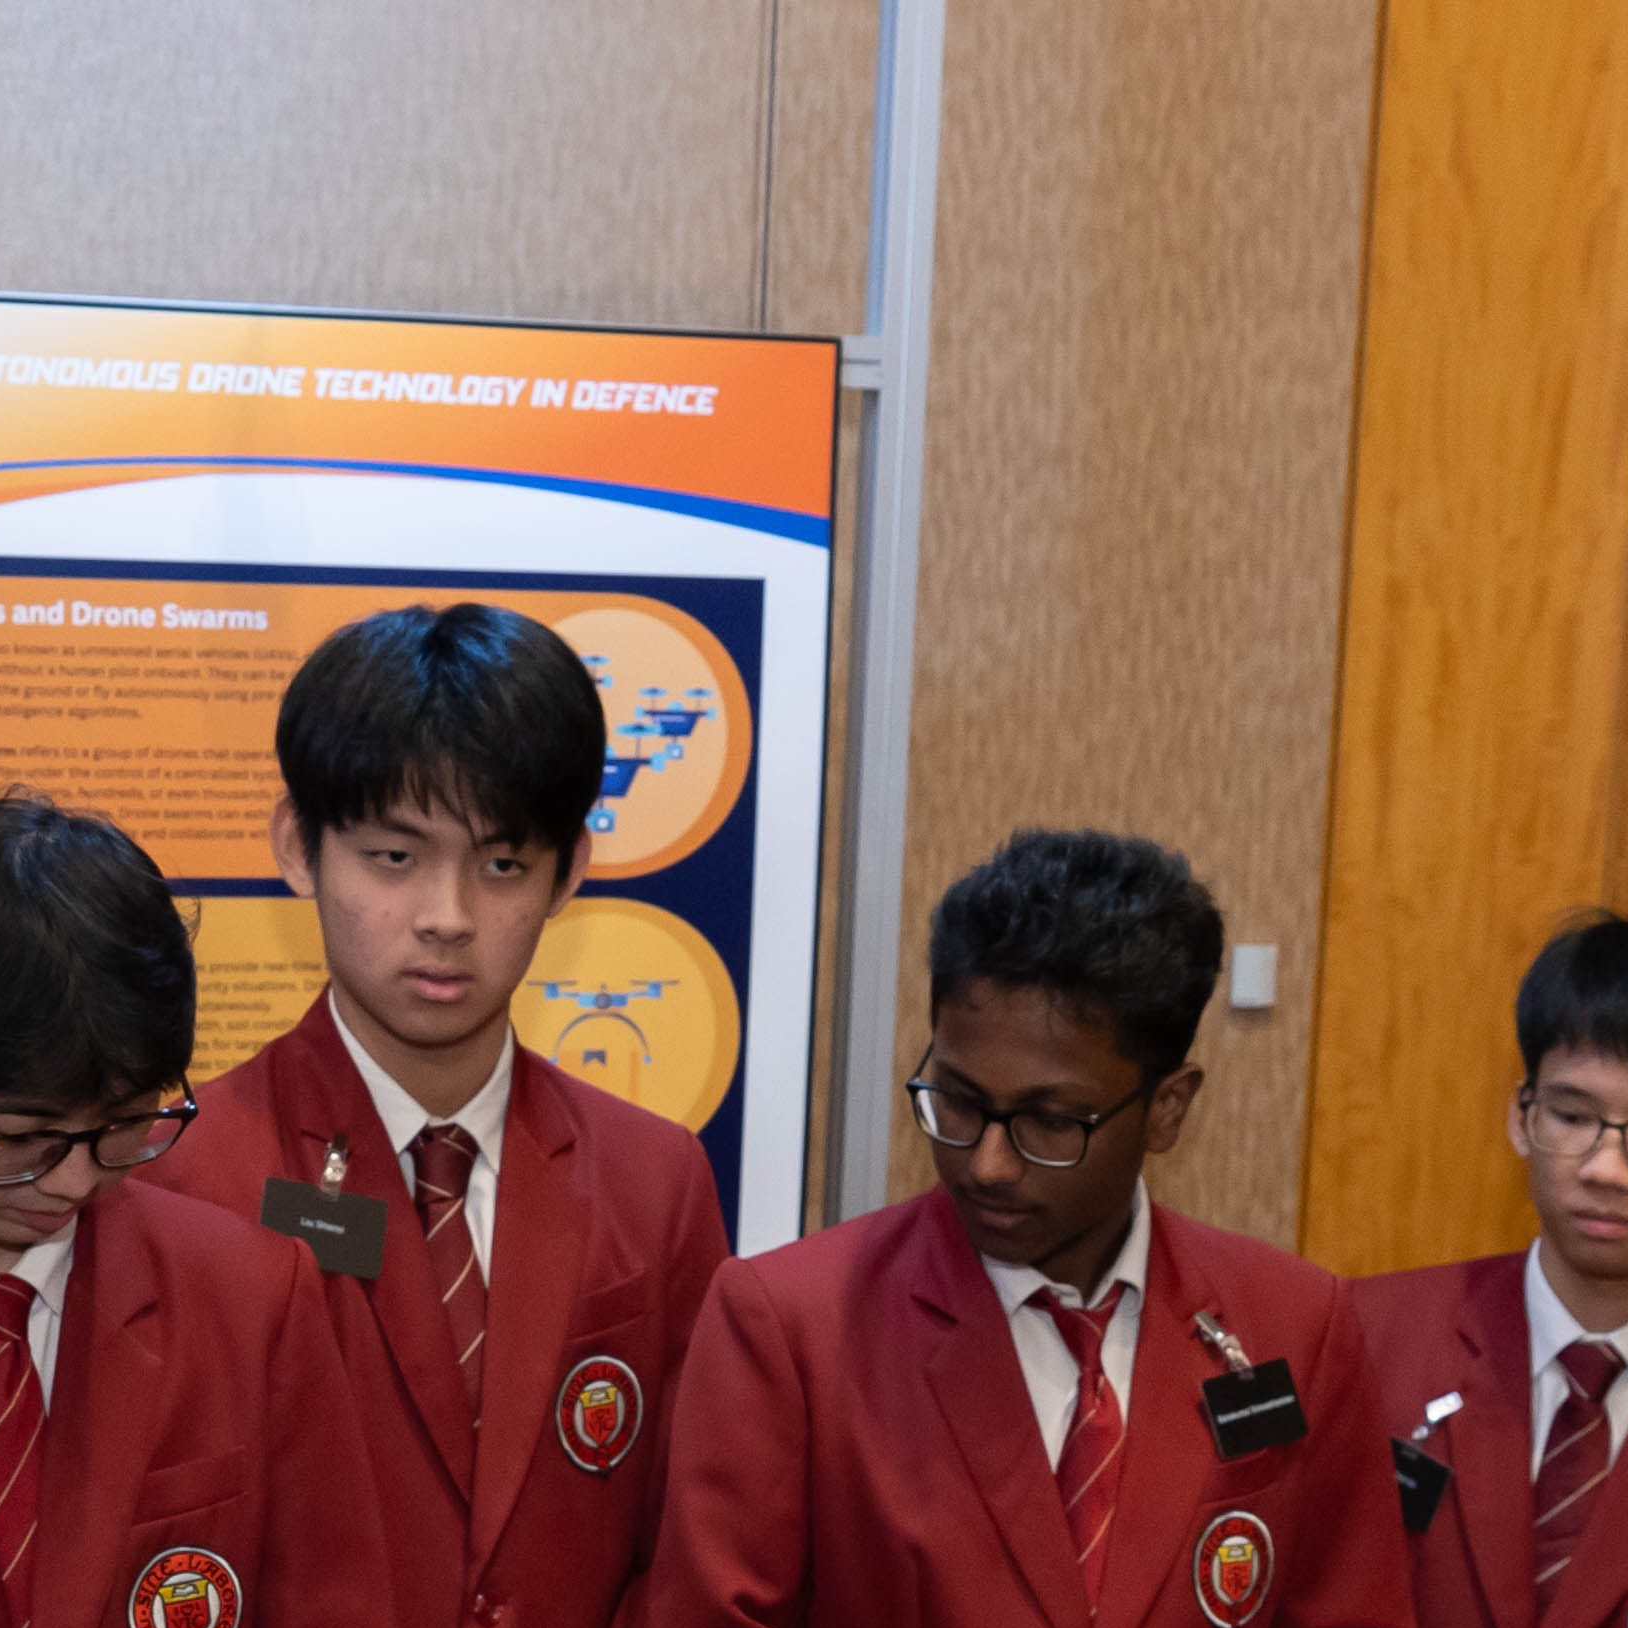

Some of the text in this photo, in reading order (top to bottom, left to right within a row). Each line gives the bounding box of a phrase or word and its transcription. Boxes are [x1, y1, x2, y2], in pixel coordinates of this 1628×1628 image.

[188, 363, 307, 397] DRONE
[314, 367, 526, 407] TECHNOLOGY
[530, 379, 569, 410] IN
[572, 380, 719, 416] DEFENCE
[12, 599, 65, 625] and
[71, 600, 156, 628] Drone
[162, 602, 268, 630] Swarms
